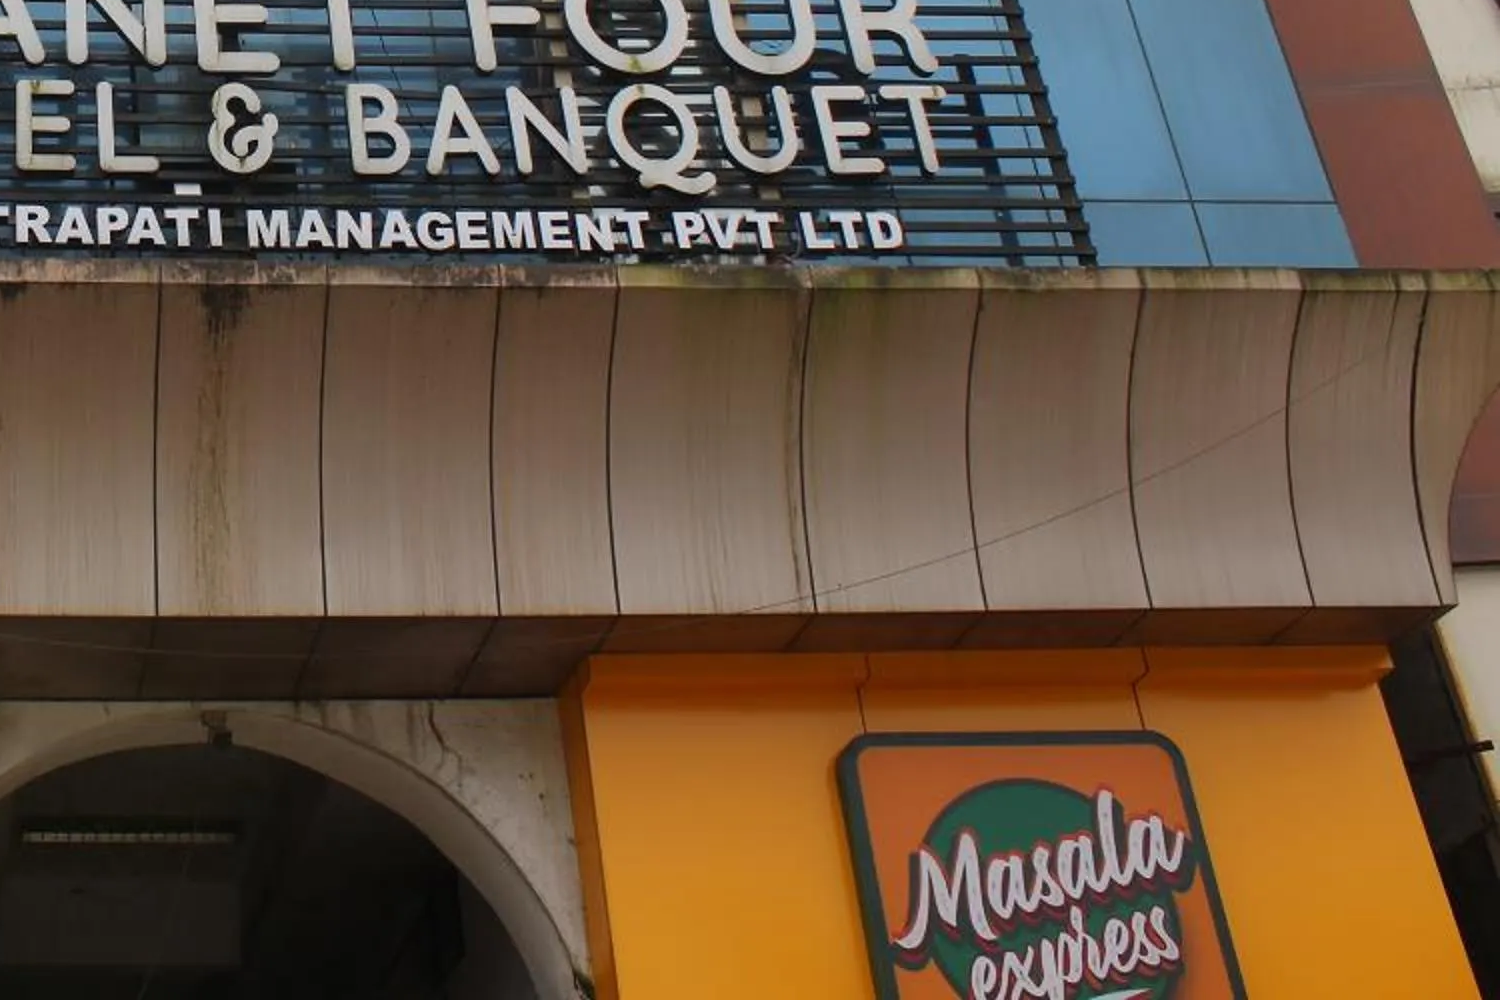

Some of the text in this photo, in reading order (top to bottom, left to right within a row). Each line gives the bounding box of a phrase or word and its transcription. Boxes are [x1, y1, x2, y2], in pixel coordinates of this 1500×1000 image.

[207, 82, 279, 174] &
[346, 83, 947, 194] BANQUET
[246, 208, 649, 252] MANAGEMENT
[672, 210, 781, 252] PVT
[798, 211, 903, 252] LTD
[891, 788, 1186, 950] Masala
[971, 905, 1181, 1000] express
